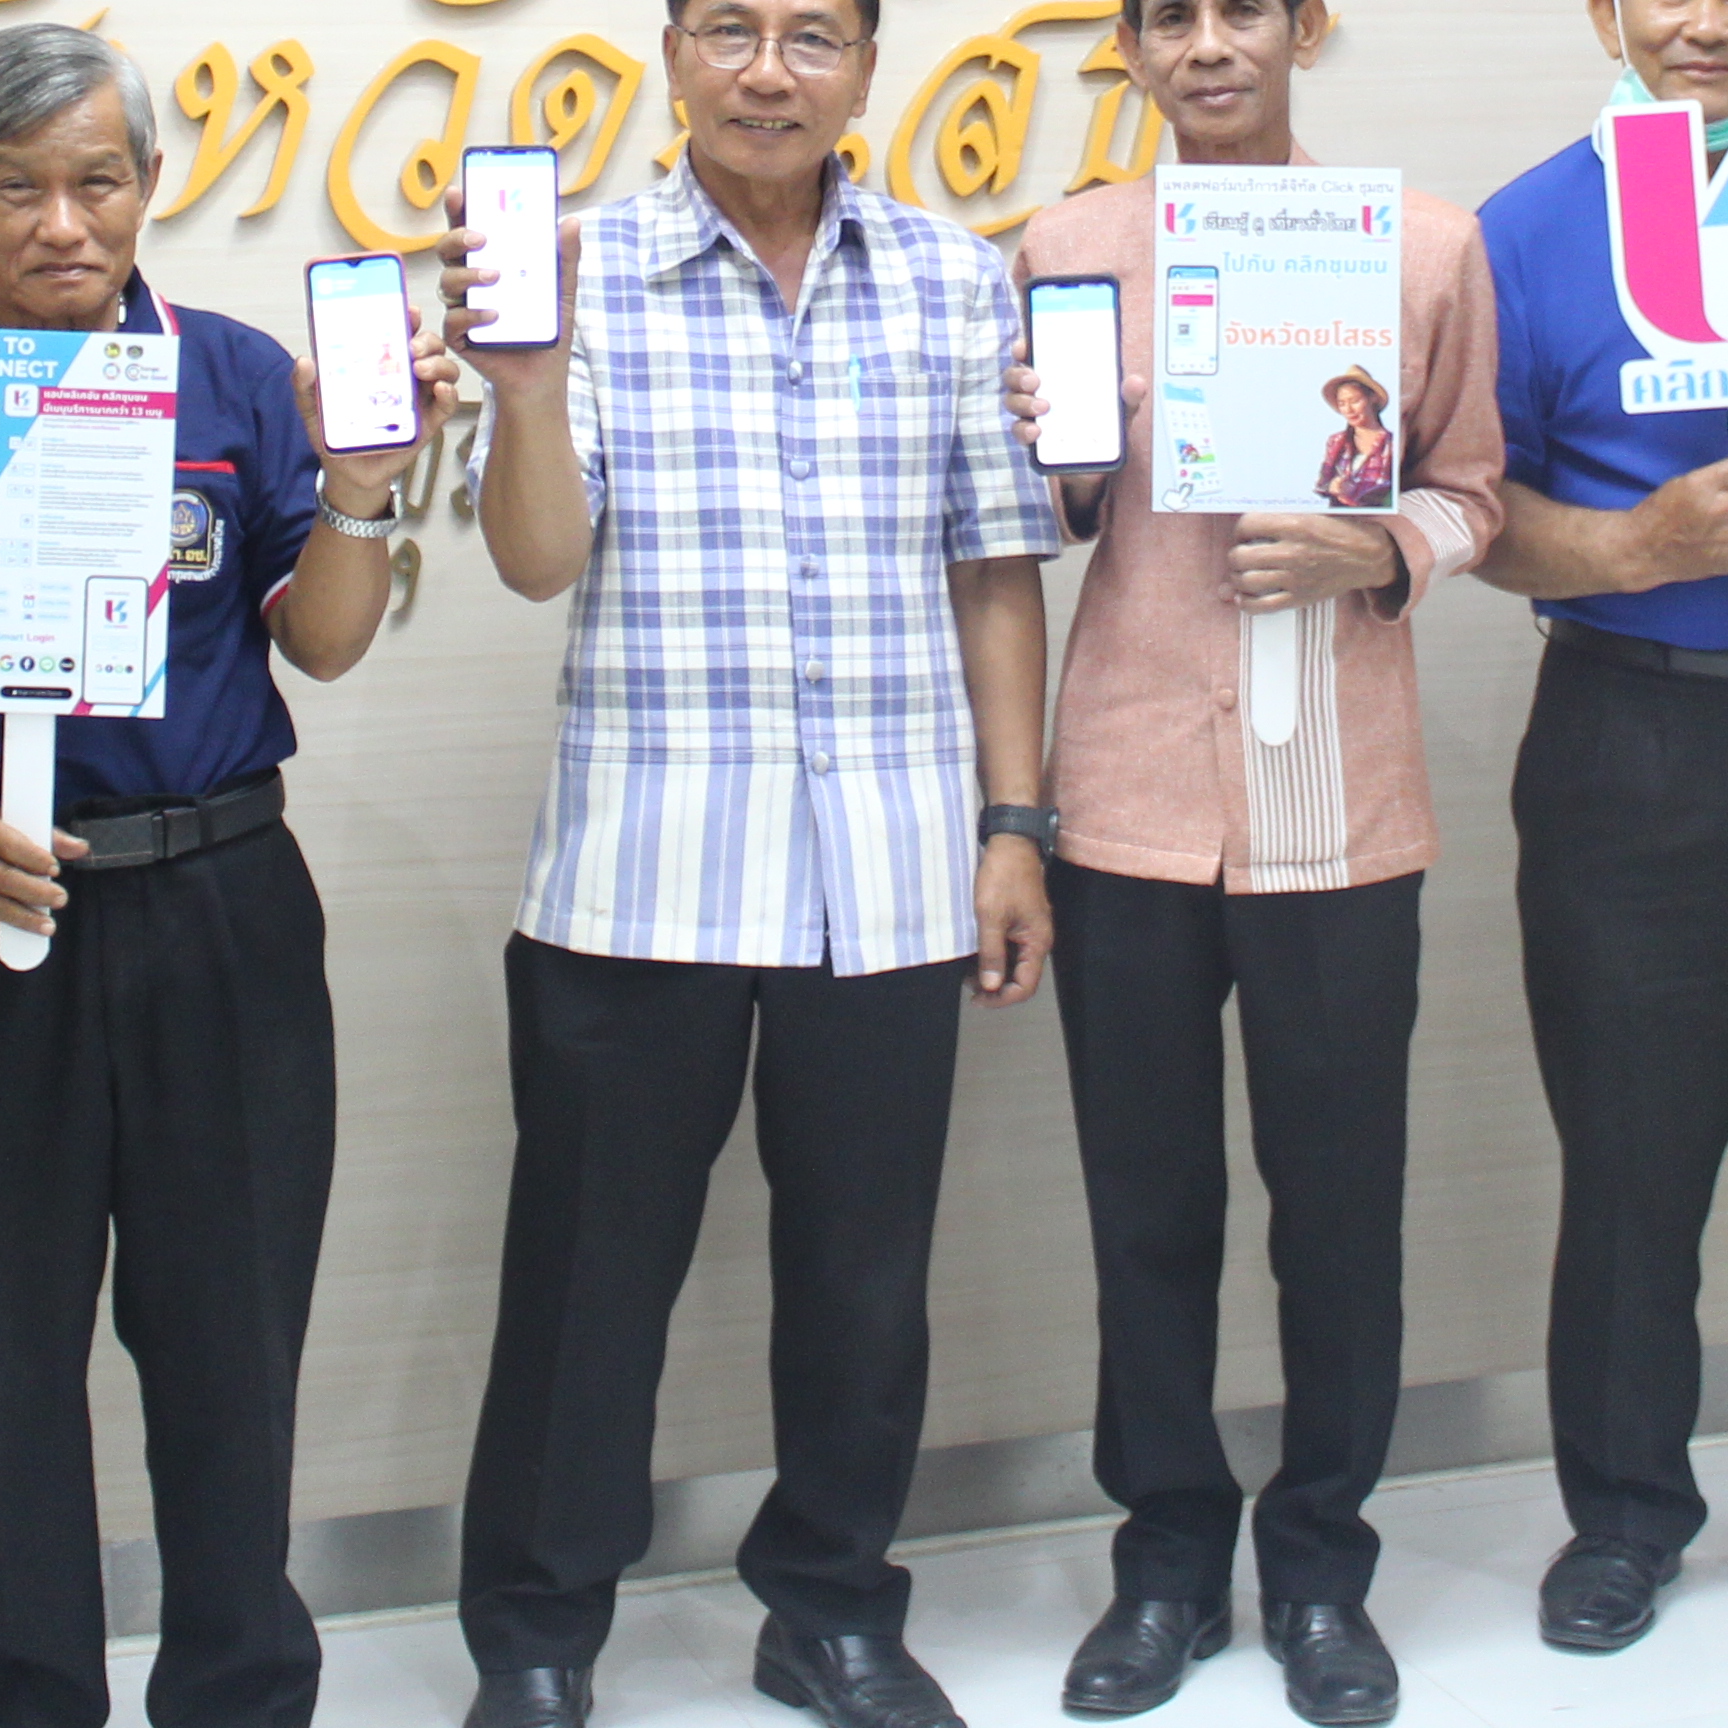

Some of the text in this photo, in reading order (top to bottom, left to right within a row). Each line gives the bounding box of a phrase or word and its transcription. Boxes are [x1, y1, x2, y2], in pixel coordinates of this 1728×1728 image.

[1321, 179, 1354, 193] Click
[1359, 181, 1395, 197] ชุมชน
[1223, 252, 1388, 279] ไปกับ คลิกชุมชน
[1224, 320, 1393, 347] จังหวัดยโสธร
[3, 336, 36, 355] TO
[102, 391, 148, 404] คลิกชุมชน
[131, 406, 143, 417] 13
[27, 632, 56, 646] Login
